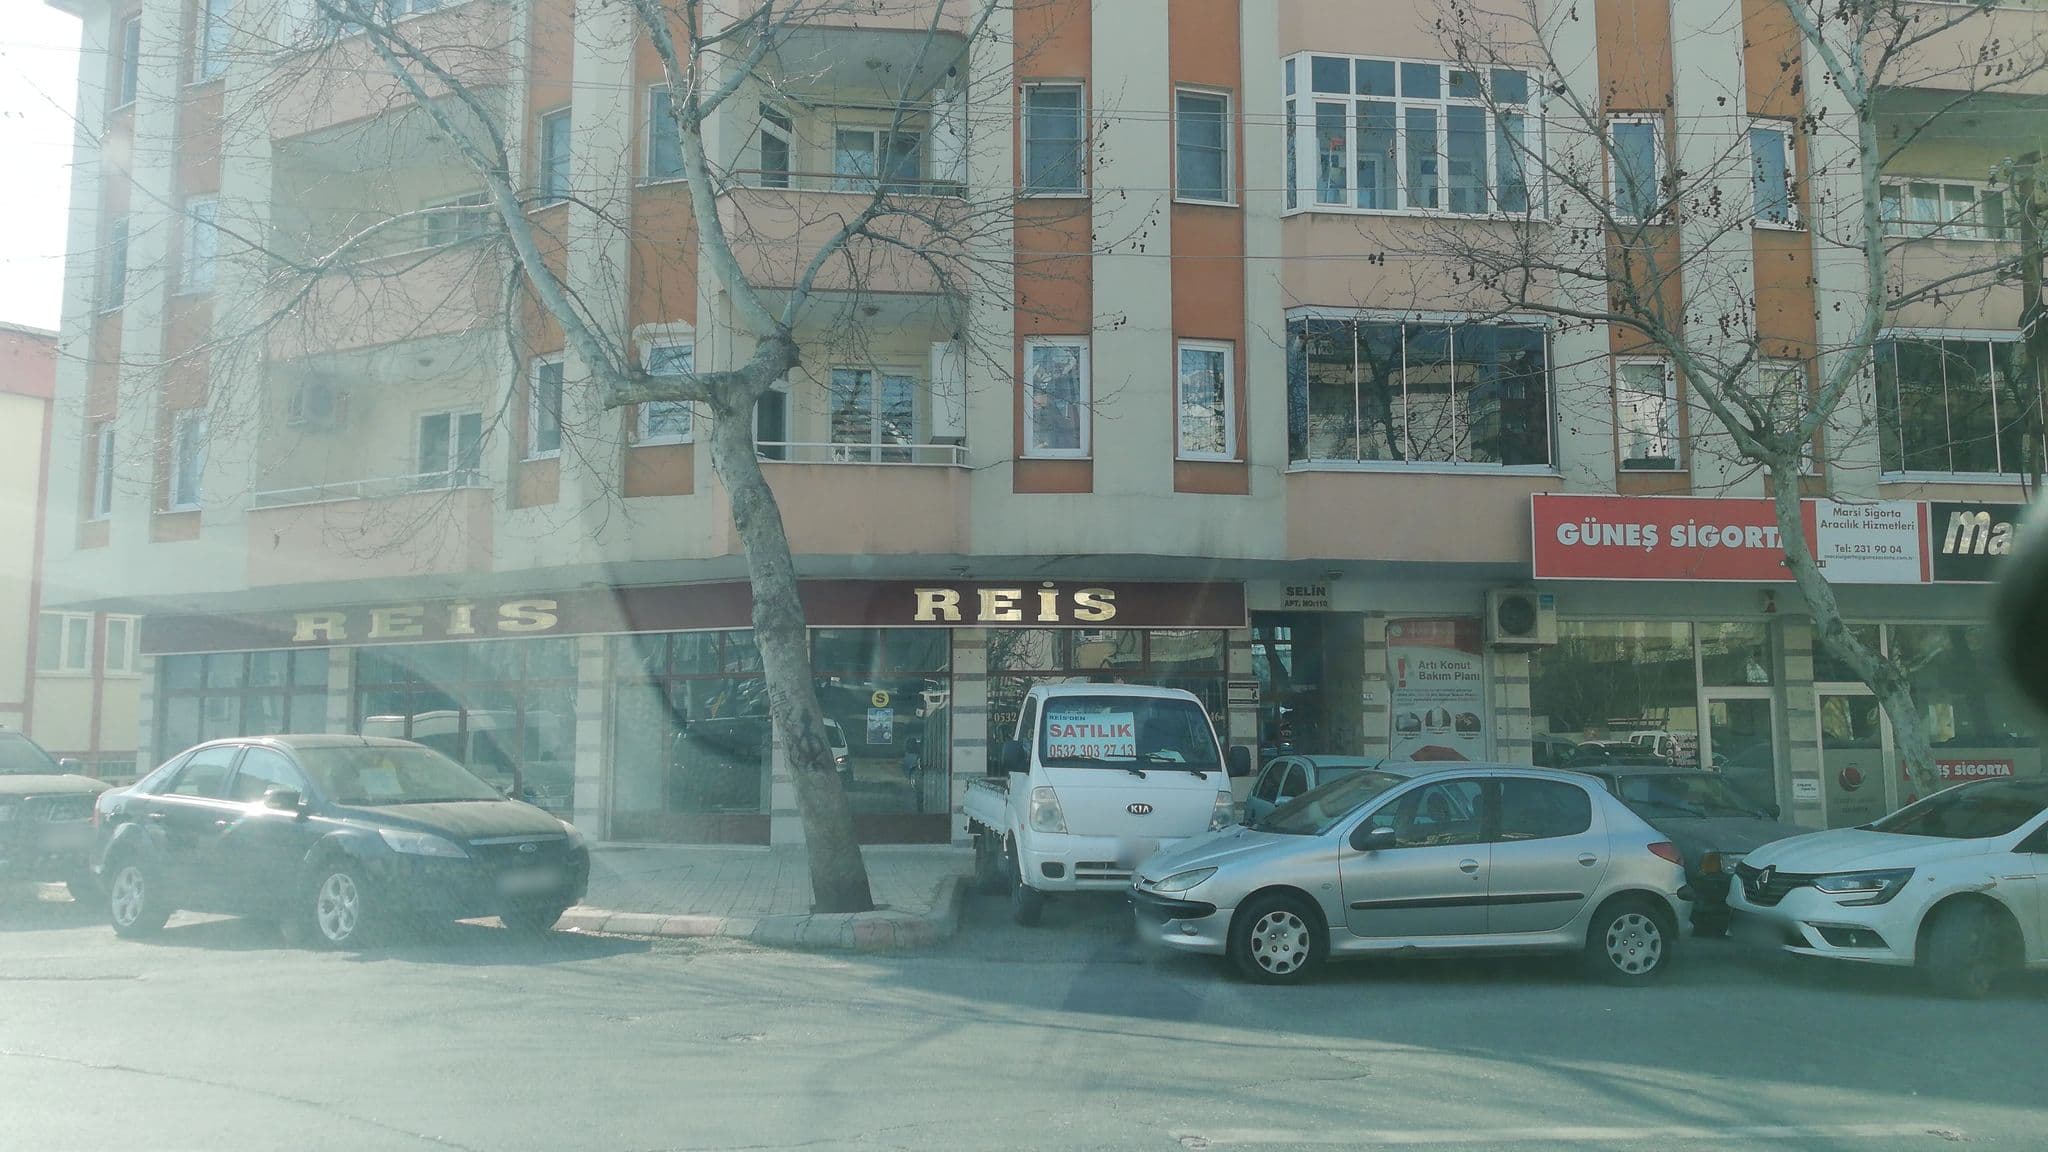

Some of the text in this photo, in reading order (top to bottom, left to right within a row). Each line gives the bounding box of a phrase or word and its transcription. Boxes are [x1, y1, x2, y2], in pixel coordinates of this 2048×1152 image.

[1833, 507, 1901, 519] Marsi Sigorta
[1820, 520, 1915, 530] Aracılık Hizmetleri
[1557, 517, 1659, 552] GÜNEŞ
[1835, 544, 1902, 554] Tel: 231 90 04
[1286, 585, 1326, 596] SELİN
[914, 581, 1117, 622] REİS
[1419, 661, 1472, 670] Artı Konut
[1419, 671, 1480, 680] Bakım Planı
[994, 712, 1017, 722] 0532
[1050, 724, 1132, 737] SATILIK
[1050, 744, 1134, 757] 0532 303 27 13
[1954, 761, 2010, 776] SİGORTA
[1130, 804, 1149, 813] KIA
